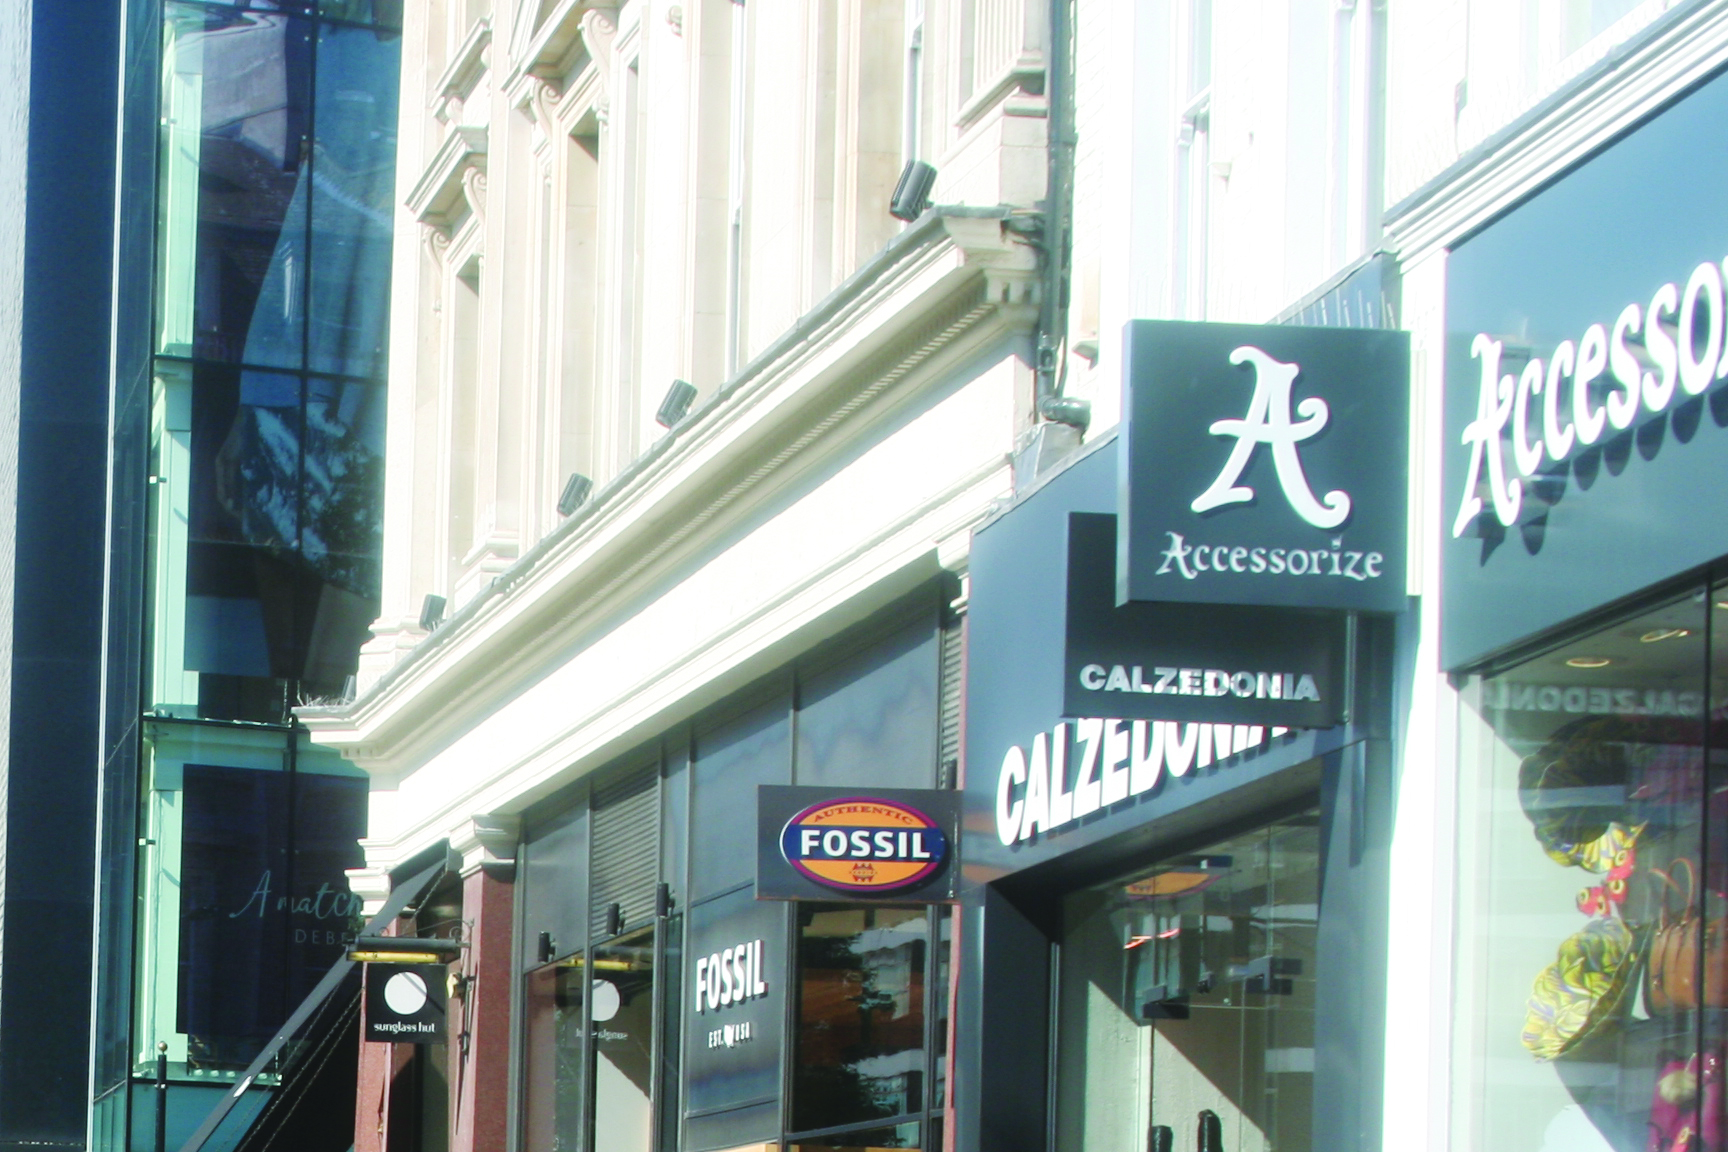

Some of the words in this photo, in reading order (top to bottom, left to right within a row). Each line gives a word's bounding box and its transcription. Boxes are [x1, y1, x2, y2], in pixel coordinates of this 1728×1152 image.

[1452, 254, 1728, 539] Accesso
[1191, 346, 1352, 530] A
[1155, 531, 1384, 582] Accessorize
[1079, 663, 1321, 702] CALZEDONIA
[813, 805, 914, 825] AUTHENTIC
[800, 829, 931, 859] FOSSIL
[695, 939, 767, 1012] FOSSIL
[373, 1021, 417, 1035] sunglass
[418, 1021, 435, 1033] hut
